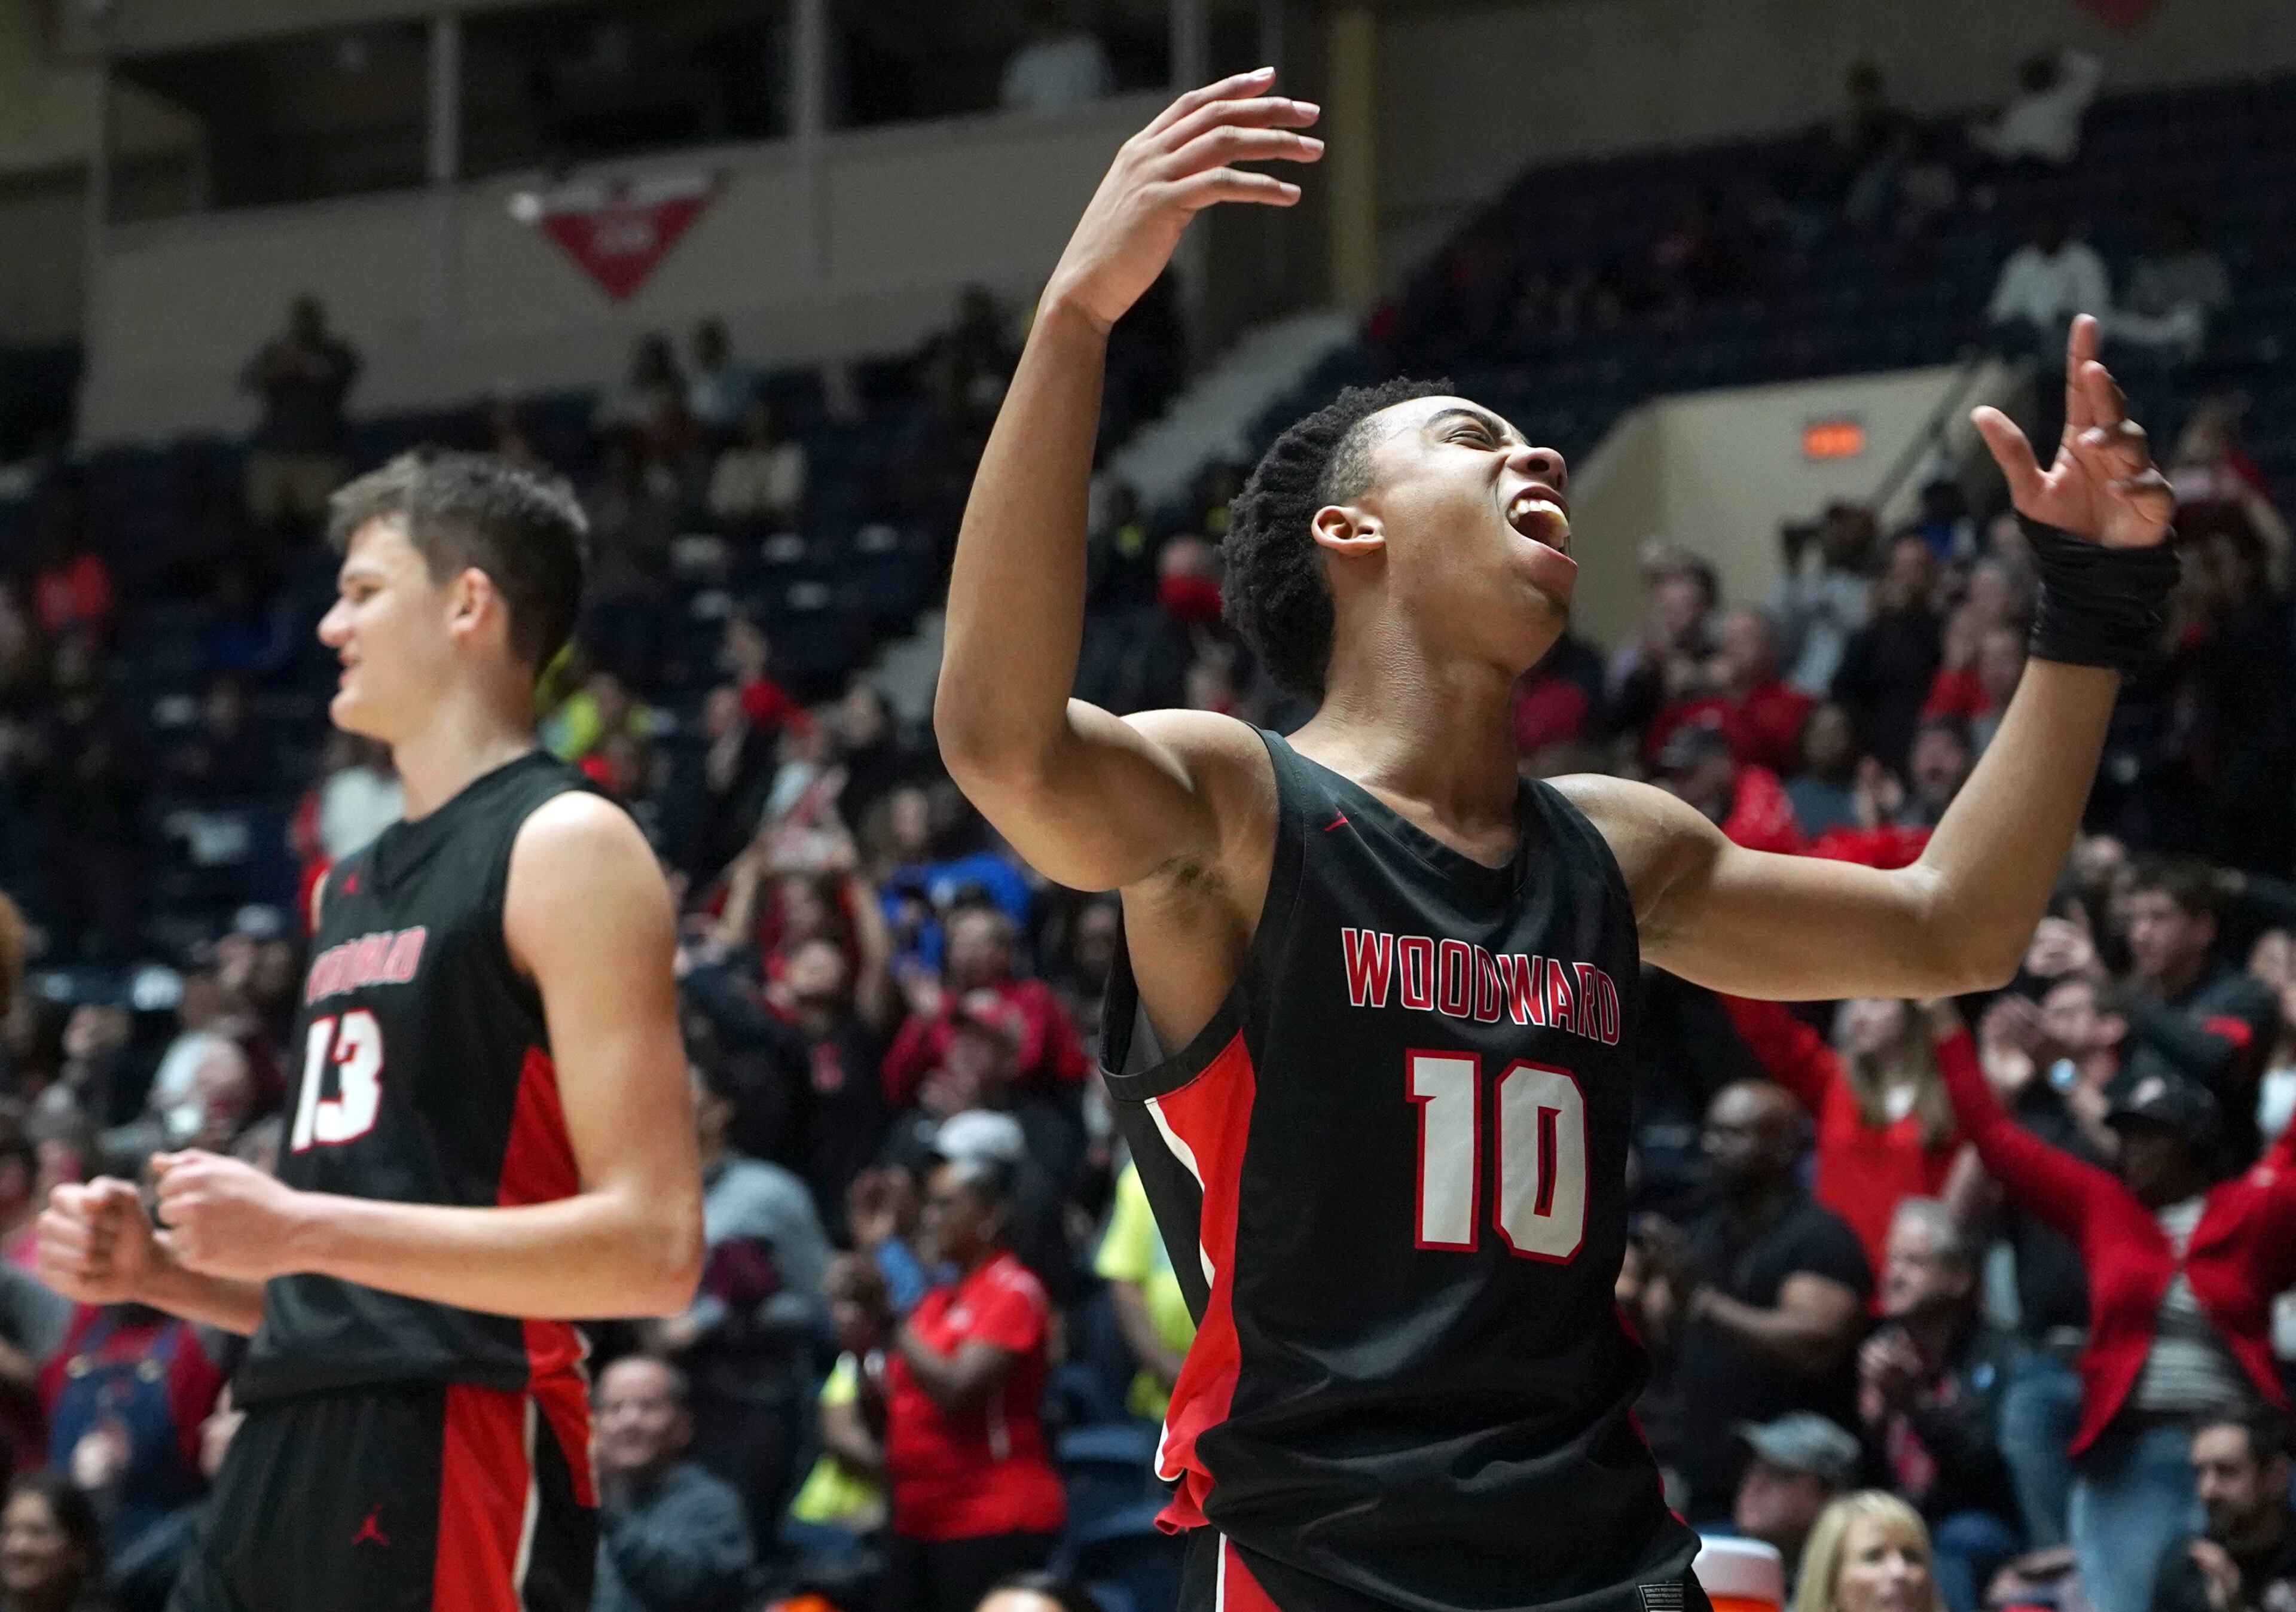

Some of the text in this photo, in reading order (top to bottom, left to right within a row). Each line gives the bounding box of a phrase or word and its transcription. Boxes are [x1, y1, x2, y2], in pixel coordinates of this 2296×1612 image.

[1341, 927, 1620, 1045] WOODWARD
[291, 1007, 383, 1153] 13
[1405, 1048, 1589, 1265] 10
